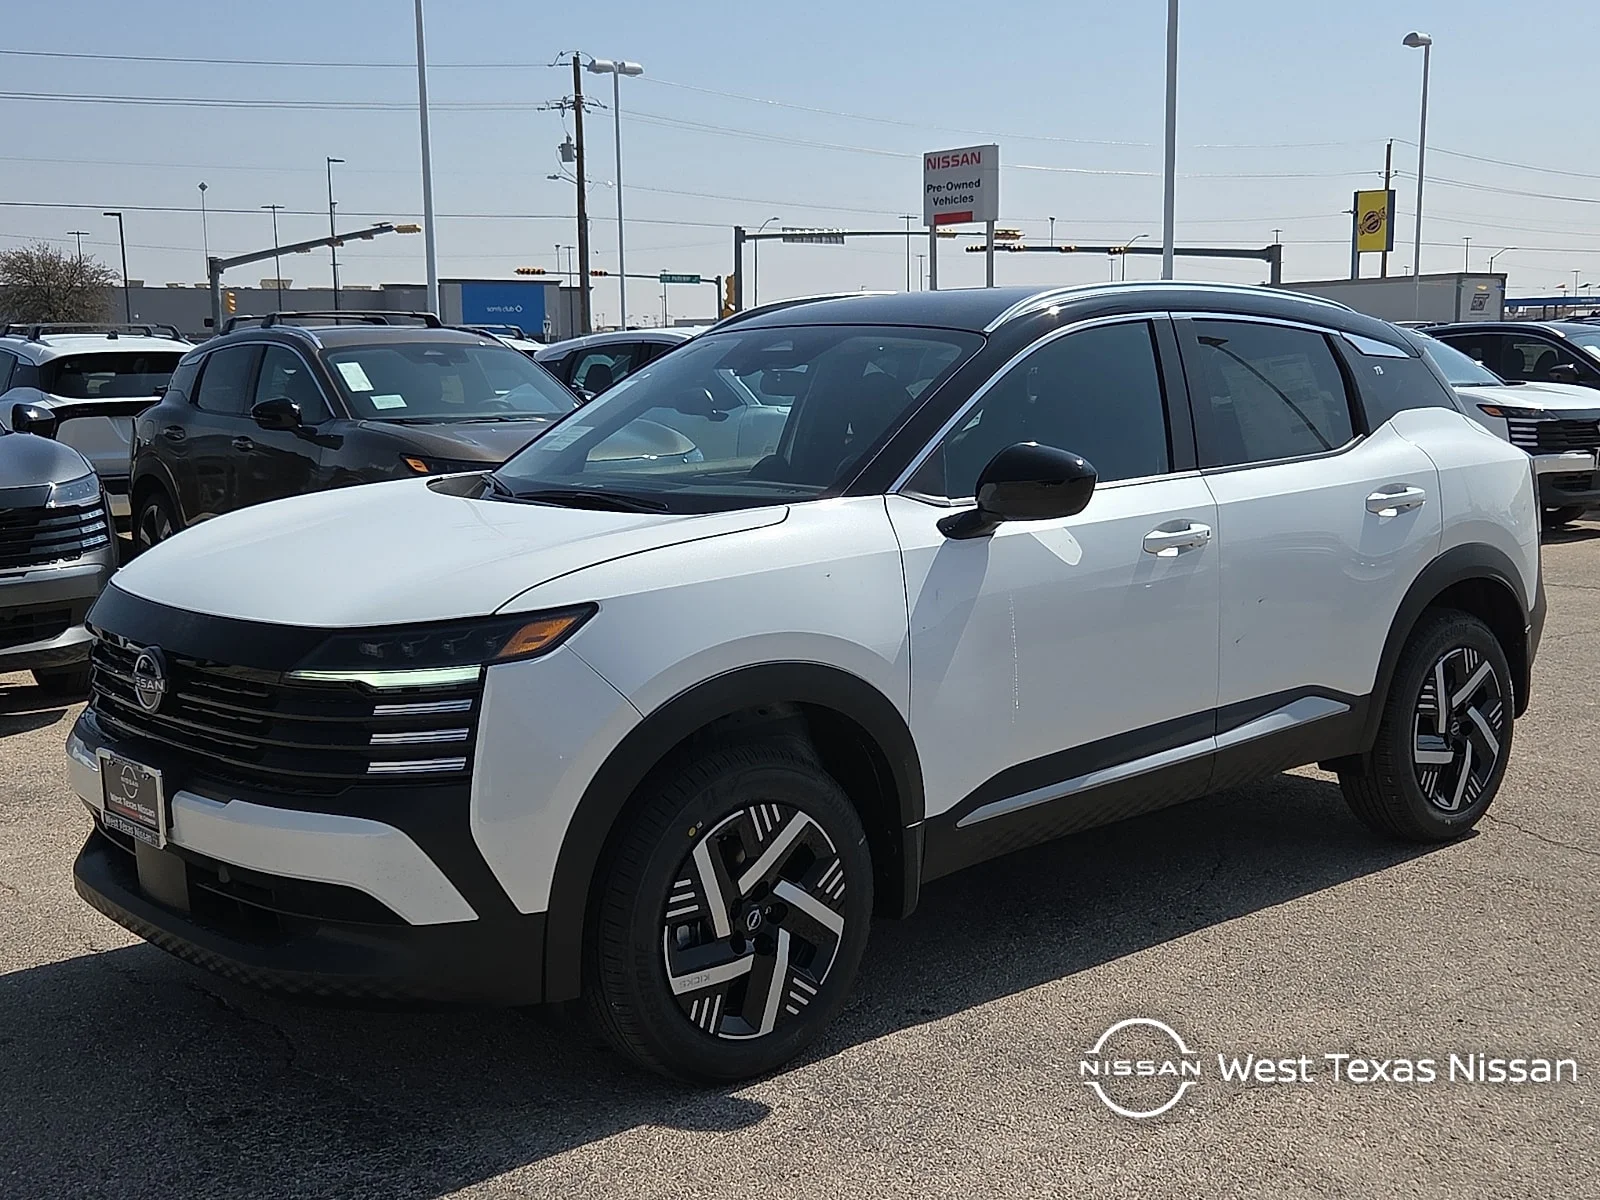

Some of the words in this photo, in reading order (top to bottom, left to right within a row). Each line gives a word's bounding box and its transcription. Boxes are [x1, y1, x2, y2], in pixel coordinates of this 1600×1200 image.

[926, 152, 981, 171] NISSAN
[926, 178, 981, 193] Pre-Owned
[932, 194, 975, 206] Vehicles
